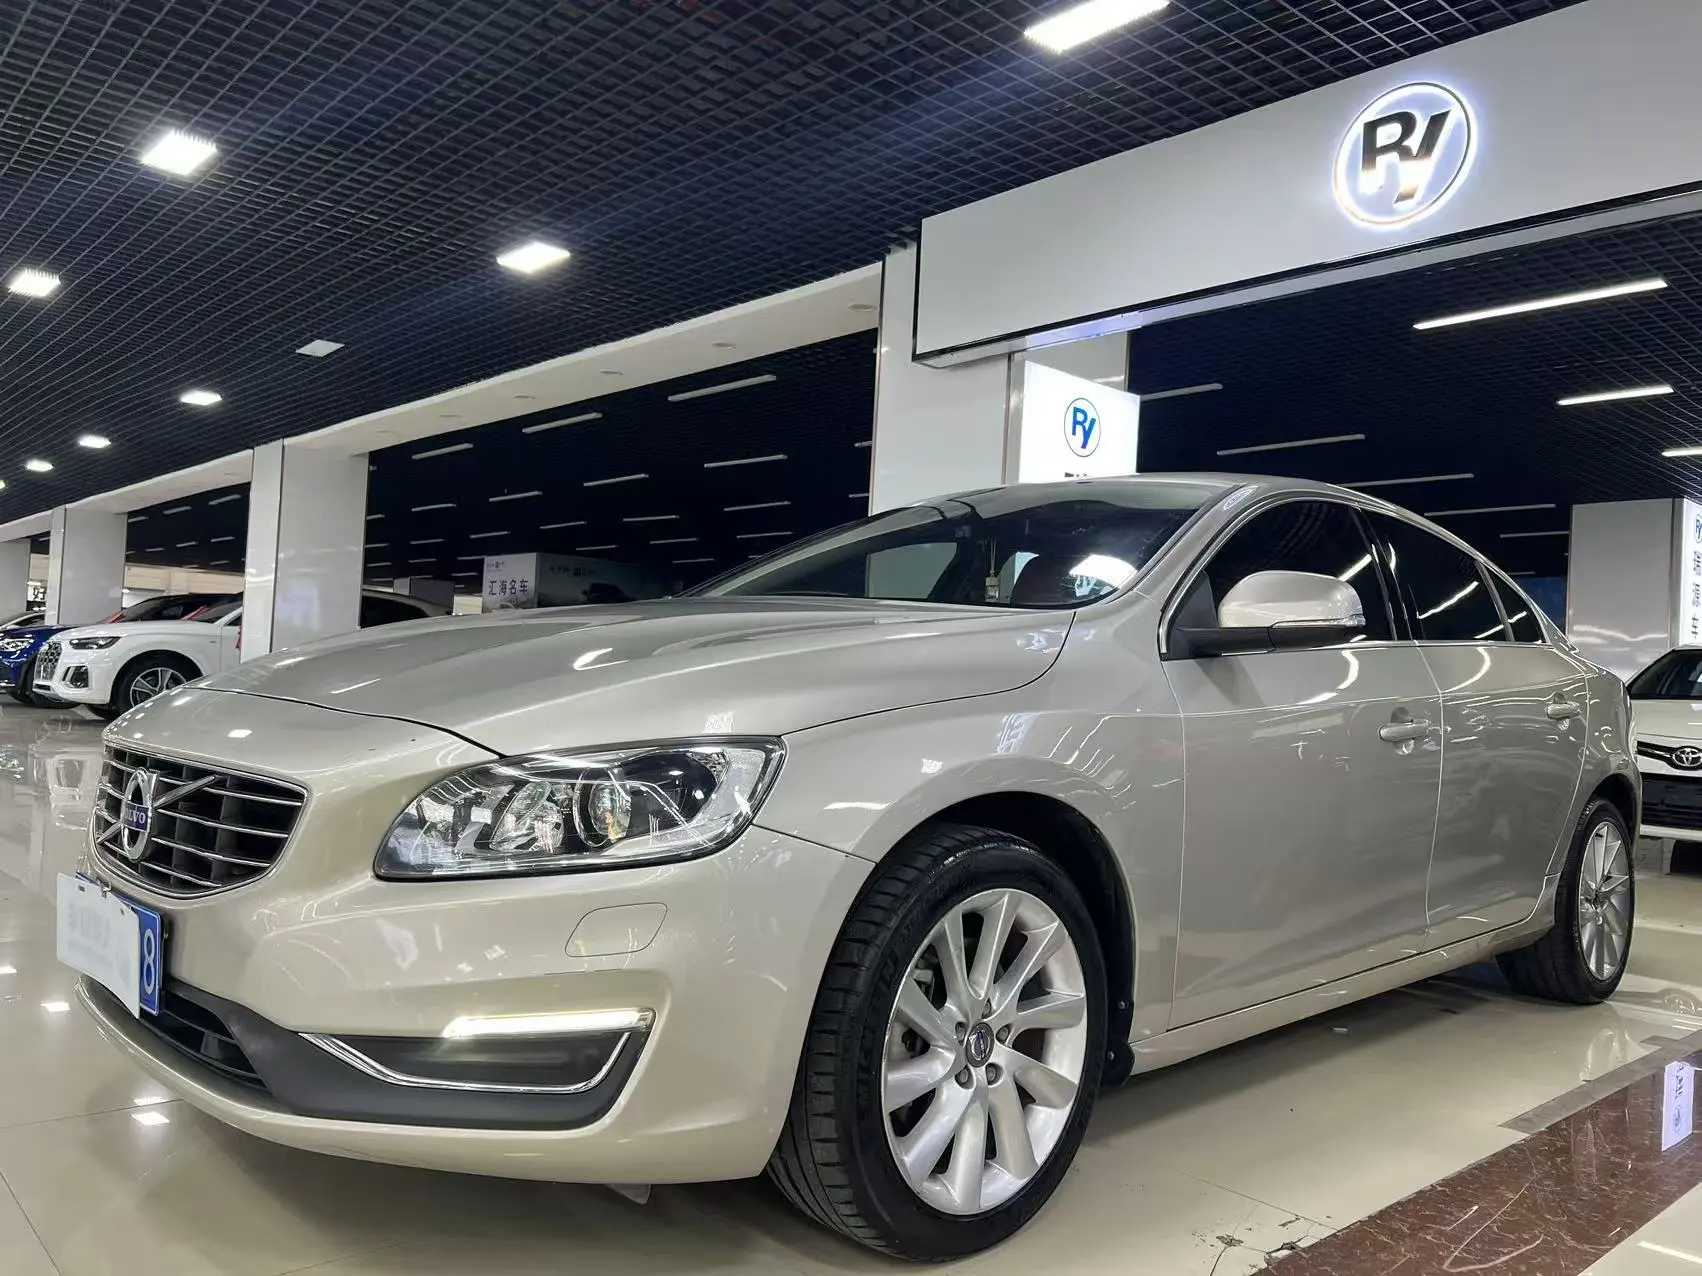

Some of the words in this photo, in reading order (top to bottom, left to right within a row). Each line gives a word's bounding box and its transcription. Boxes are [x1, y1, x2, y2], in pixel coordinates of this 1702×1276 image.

[488, 579, 529, 596] 汇海名车
[143, 928, 156, 996] 8
